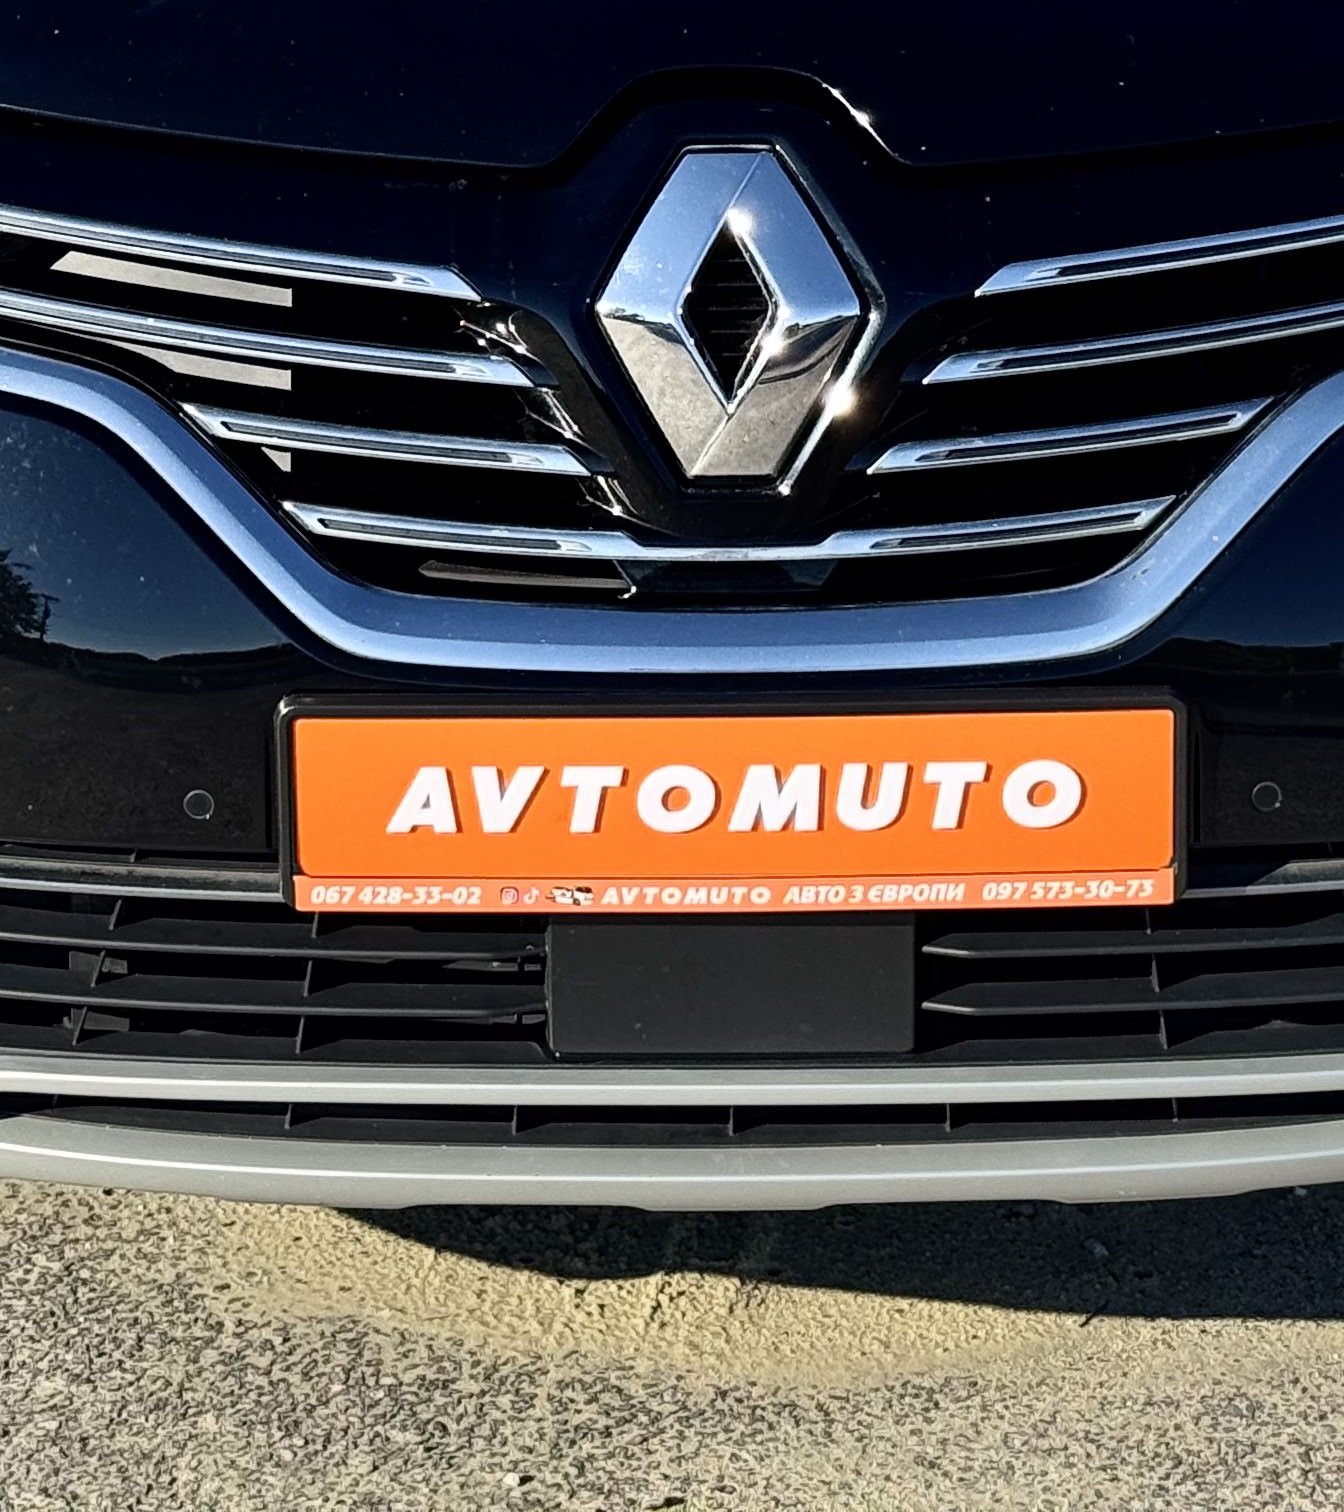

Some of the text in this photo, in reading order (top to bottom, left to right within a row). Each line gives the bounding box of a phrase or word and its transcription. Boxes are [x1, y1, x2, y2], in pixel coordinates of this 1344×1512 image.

[386, 759, 1087, 835] AVTOMUTO
[310, 885, 772, 906] 067 428-33-02 AVTOMUTO
[783, 884, 847, 904] АВТО
[982, 878, 1154, 900] 097 573-30-73
